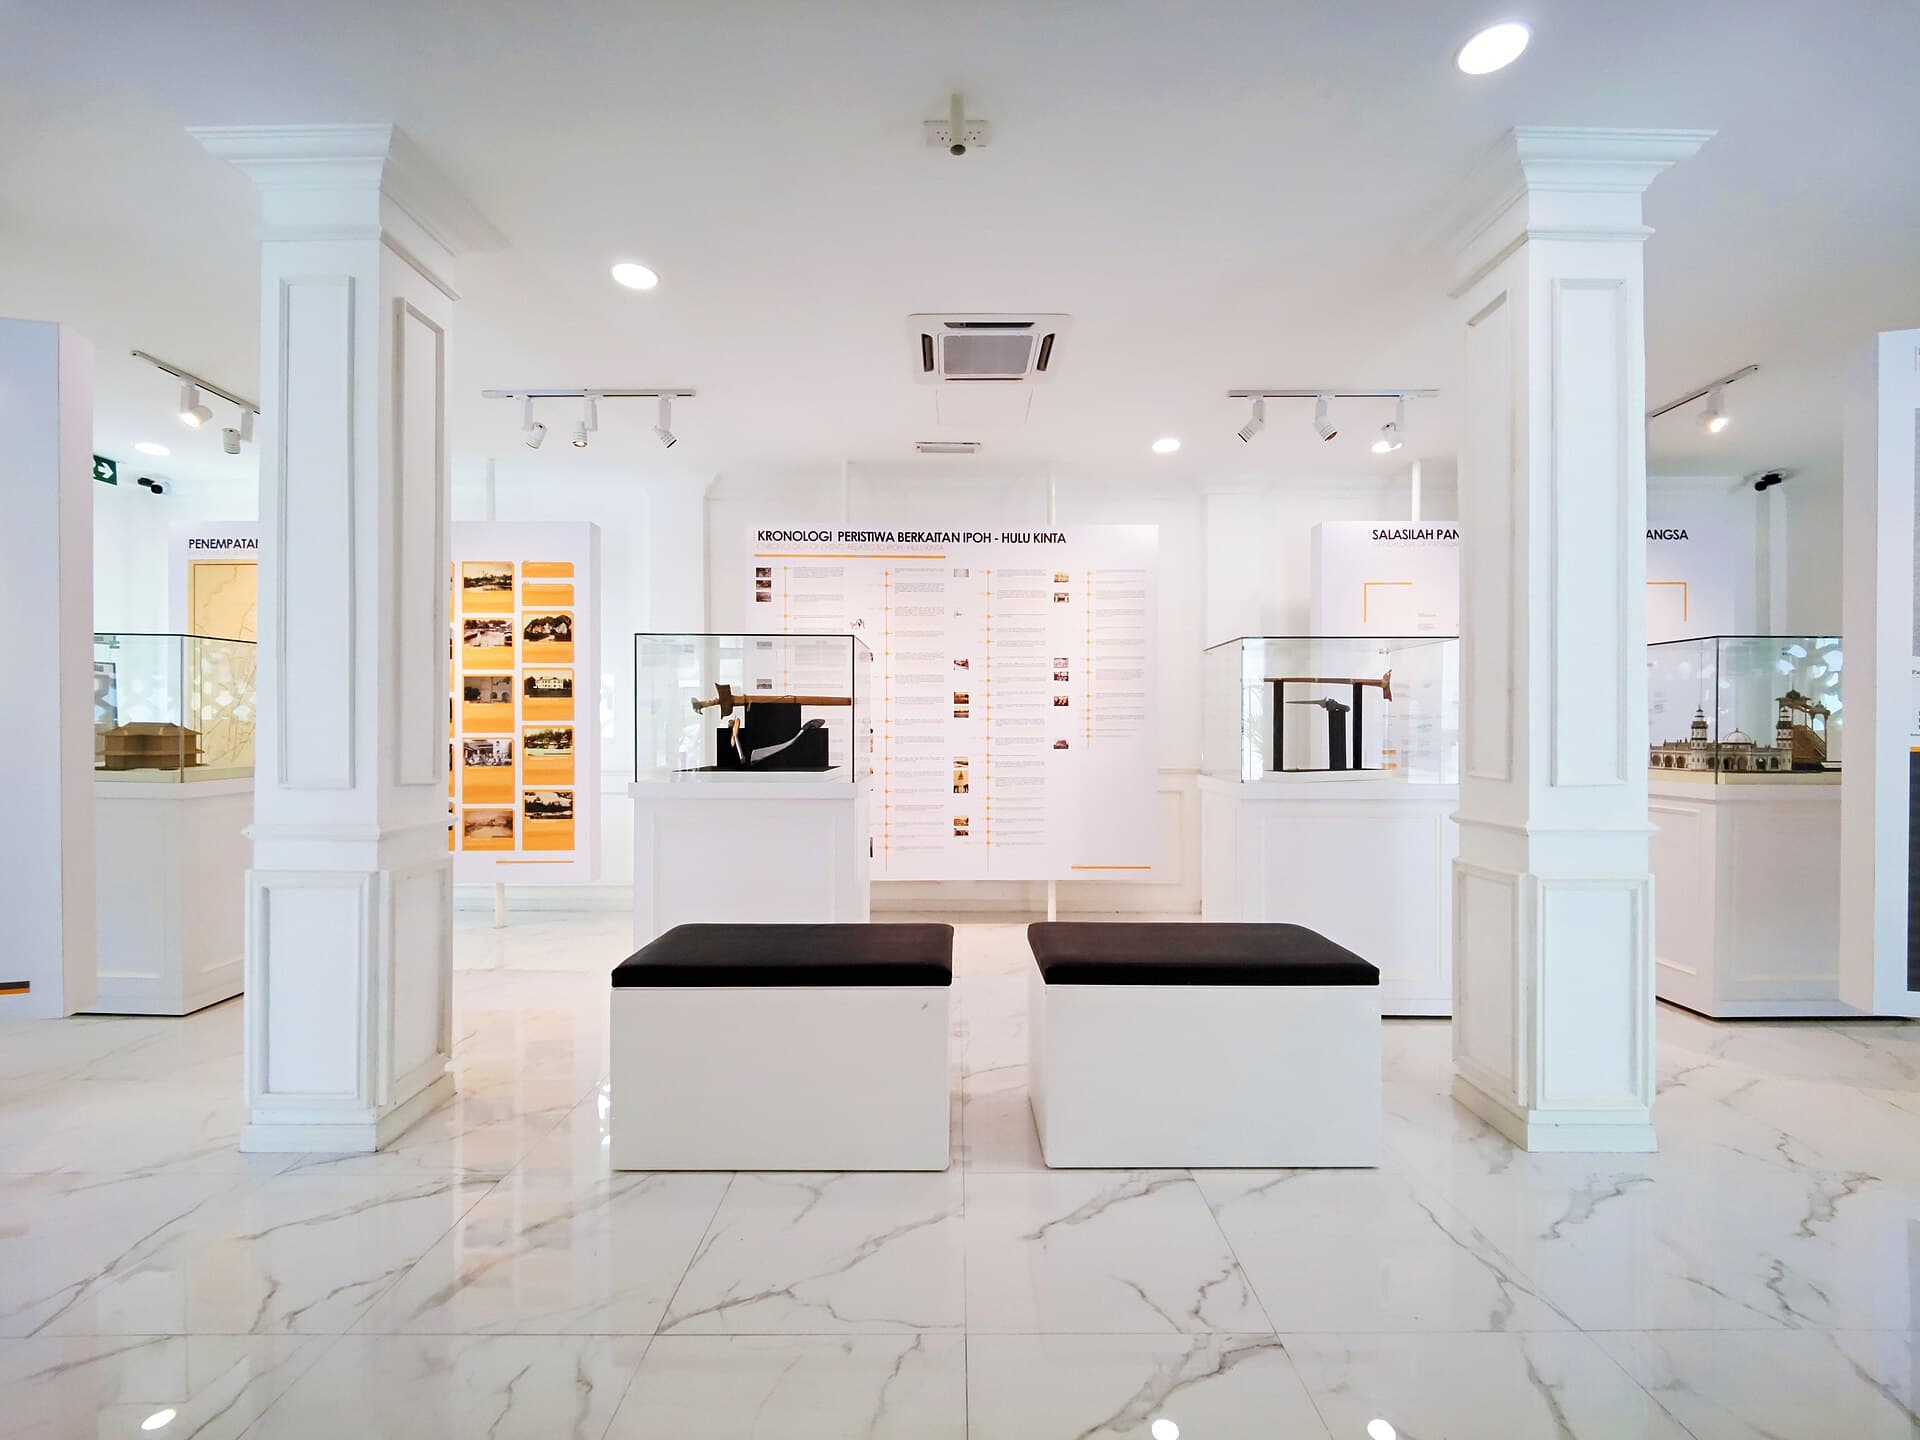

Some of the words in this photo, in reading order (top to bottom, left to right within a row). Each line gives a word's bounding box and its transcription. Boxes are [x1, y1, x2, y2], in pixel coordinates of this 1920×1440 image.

[757, 530, 833, 542] KRONOLOGI
[837, 530, 896, 543] PERISTIWA
[897, 531, 961, 543] BERKAITAN
[962, 531, 992, 544] IPOH
[1001, 532, 1031, 544] HULU
[1033, 532, 1067, 544] KINTA
[1372, 528, 1434, 541] SALASILAH
[188, 538, 259, 550] PENEMPATA
